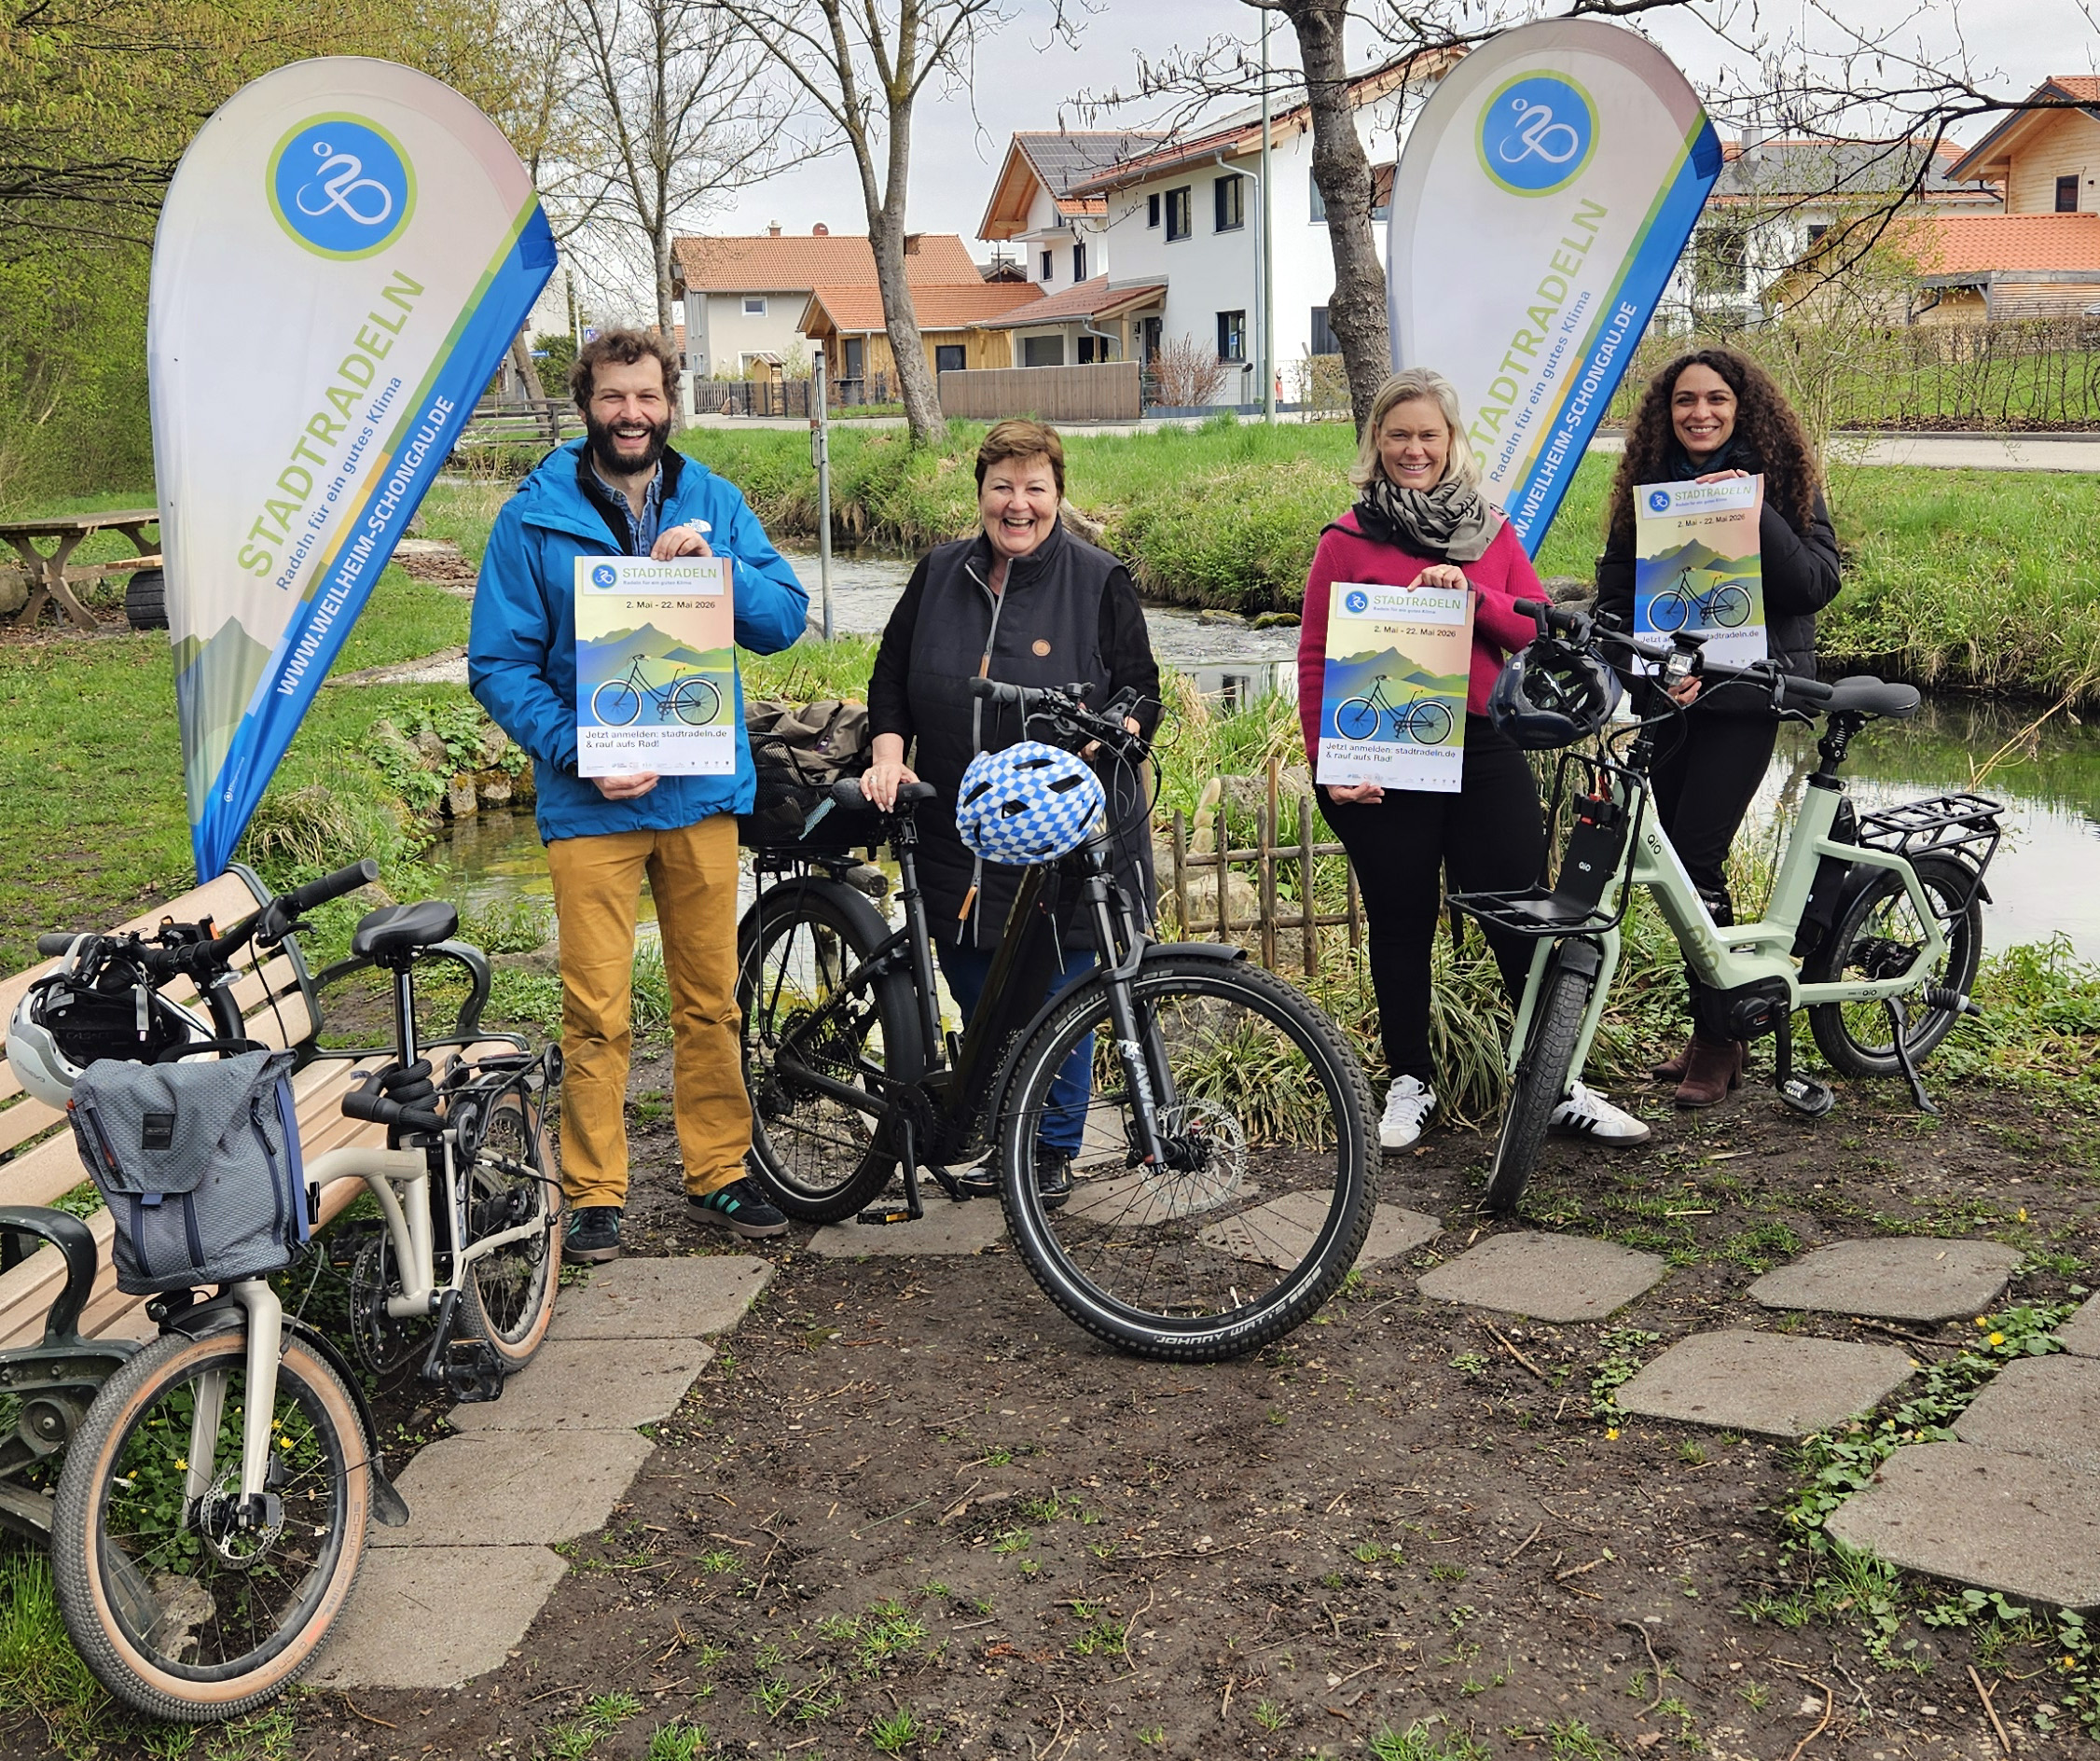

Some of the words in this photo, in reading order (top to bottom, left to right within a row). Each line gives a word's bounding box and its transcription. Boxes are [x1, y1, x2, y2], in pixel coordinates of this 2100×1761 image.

[1489, 432, 1522, 483] Radeln
[1515, 407, 1534, 430] für
[1529, 381, 1546, 405] ein
[1543, 336, 1568, 380] gutes
[1561, 291, 1591, 334] Klima
[238, 270, 425, 577] STADTRADELN
[1513, 300, 1637, 538] W.WEILHEIM-SCHONGAU.DE
[276, 531, 316, 591] Radeln
[309, 505, 331, 532] für
[326, 475, 346, 503] ein
[342, 426, 374, 474] gutes
[366, 377, 402, 425] Klima
[1675, 486, 1751, 501] STADTRADELN
[1685, 519, 1697, 527] Mai
[277, 395, 455, 696] WWW.WEILHEIM-SCHONGAU.DE
[623, 567, 717, 578] STADTRADELN
[1374, 595, 1460, 609] STADTRADELN
[1437, 629, 1457, 637] 2026
[1706, 631, 1759, 641] tadtradeln.de
[586, 730, 609, 739] Jetzt
[612, 730, 659, 739] anmelden:
[595, 740, 615, 748] rauf
[1349, 745, 1393, 754] anmelden:
[1395, 748, 1456, 758] stadtradeln.de
[1647, 834, 1662, 854] QiO
[1133, 1061, 1156, 1117] AWL
[1156, 1331, 1224, 1345] JOHNNY
[1230, 1302, 1286, 1337] WATTS
